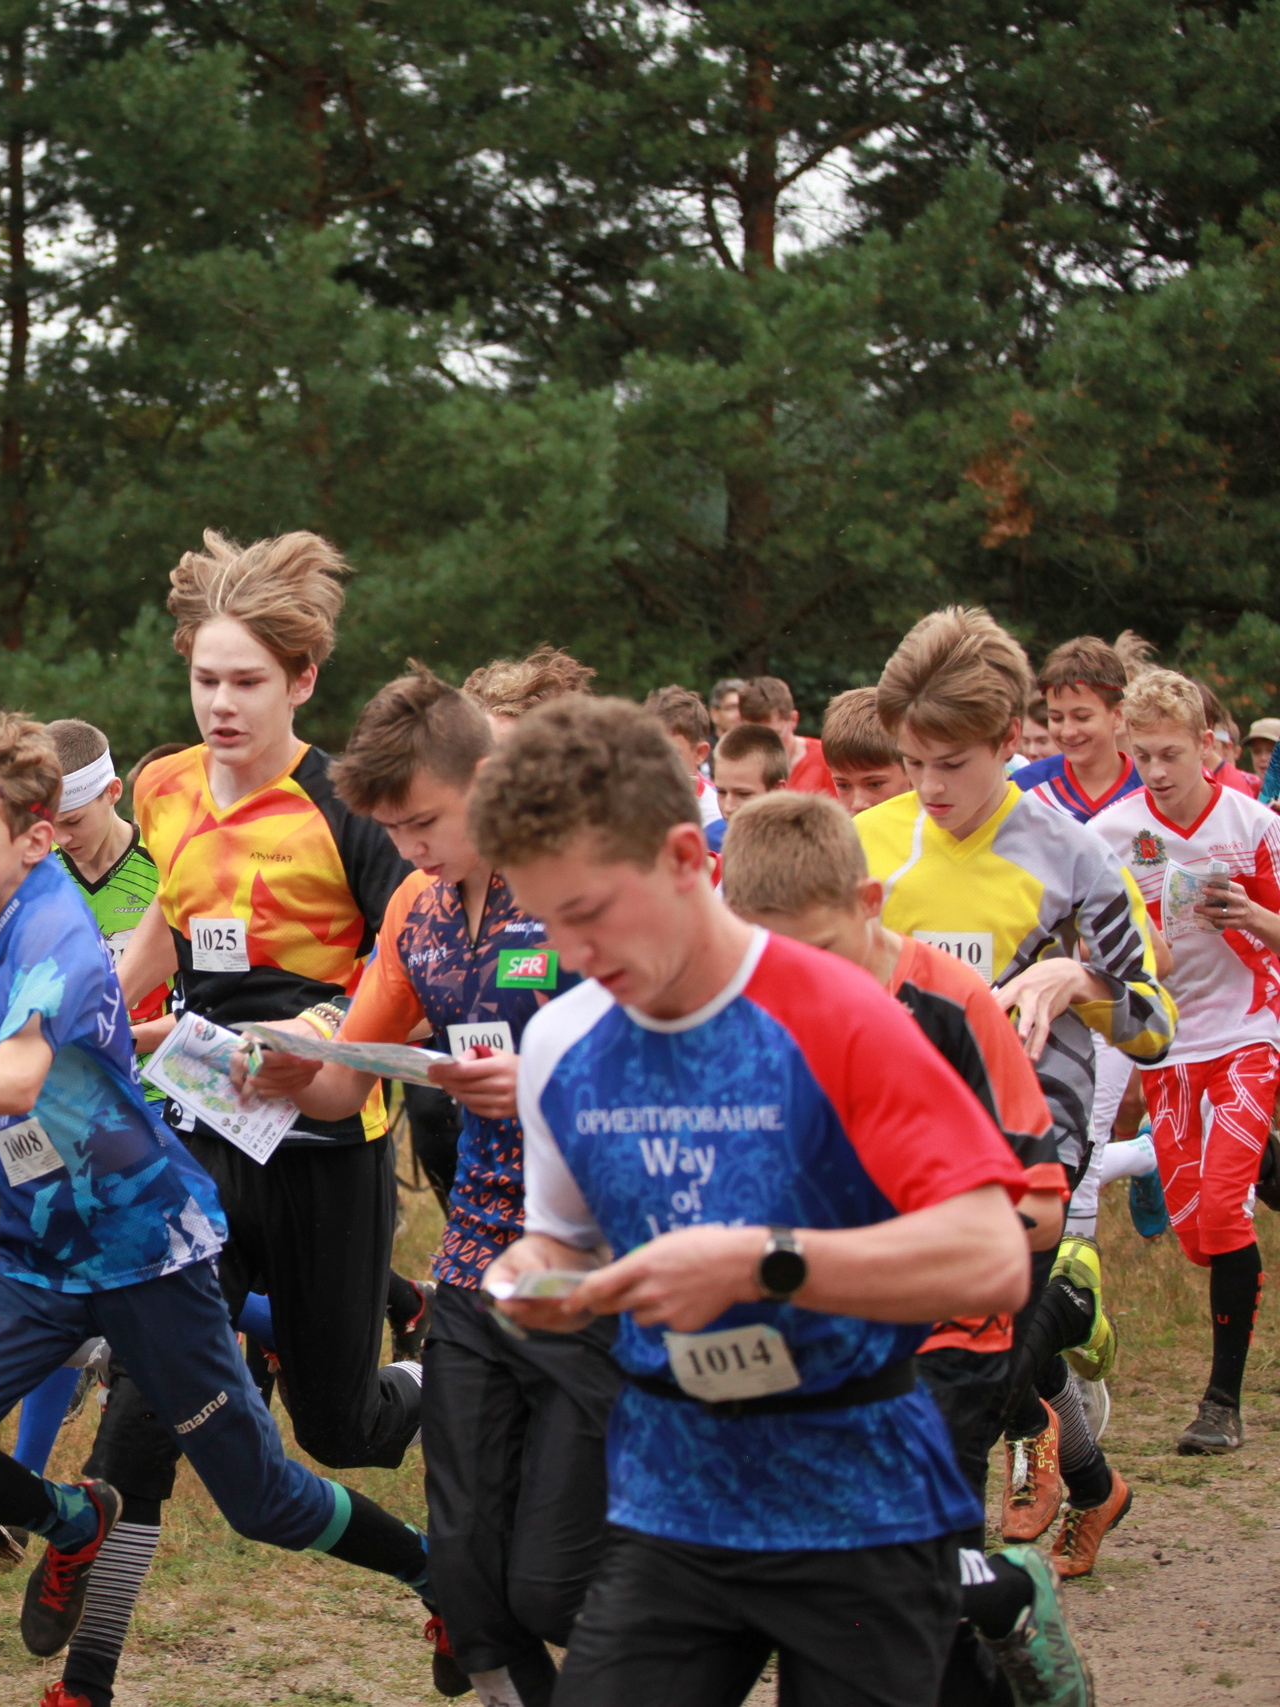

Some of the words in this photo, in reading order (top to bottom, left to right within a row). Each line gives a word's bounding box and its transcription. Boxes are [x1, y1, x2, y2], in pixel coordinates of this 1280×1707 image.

[196, 928, 238, 951] 1025
[509, 956, 543, 974] SFR
[576, 1104, 785, 1136] ОРИЕНТИРОВАНИЕ
[3, 1129, 43, 1162] 1008
[638, 1137, 716, 1186] Way
[671, 1179, 702, 1214] of
[687, 1338, 772, 1376] 1014
